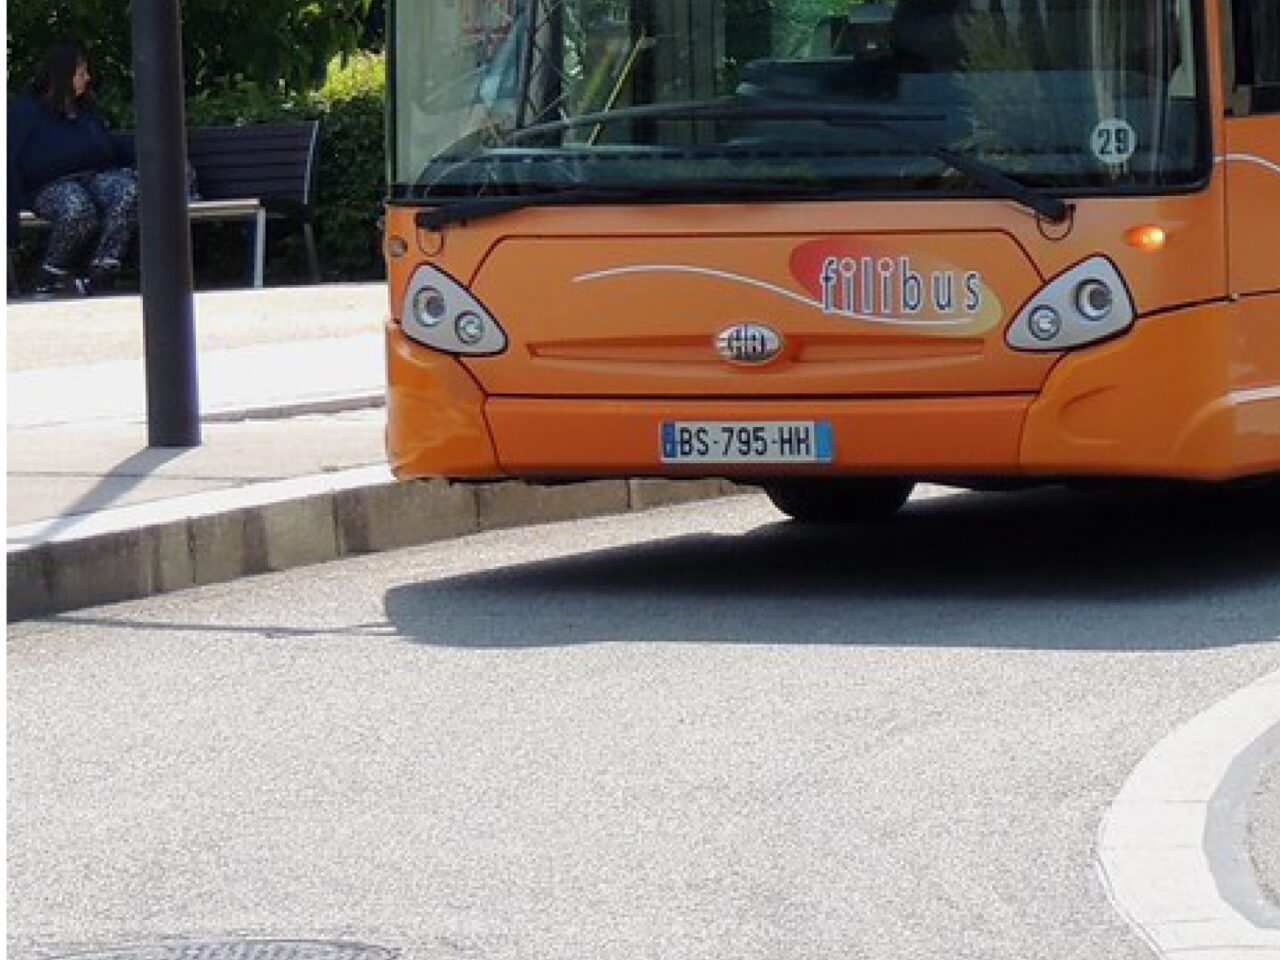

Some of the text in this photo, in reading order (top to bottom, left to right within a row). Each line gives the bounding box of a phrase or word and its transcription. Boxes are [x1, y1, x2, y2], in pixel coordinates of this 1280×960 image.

[1098, 128, 1130, 155] 29
[820, 255, 982, 314] filibus
[679, 426, 810, 456] BS-795-HH
